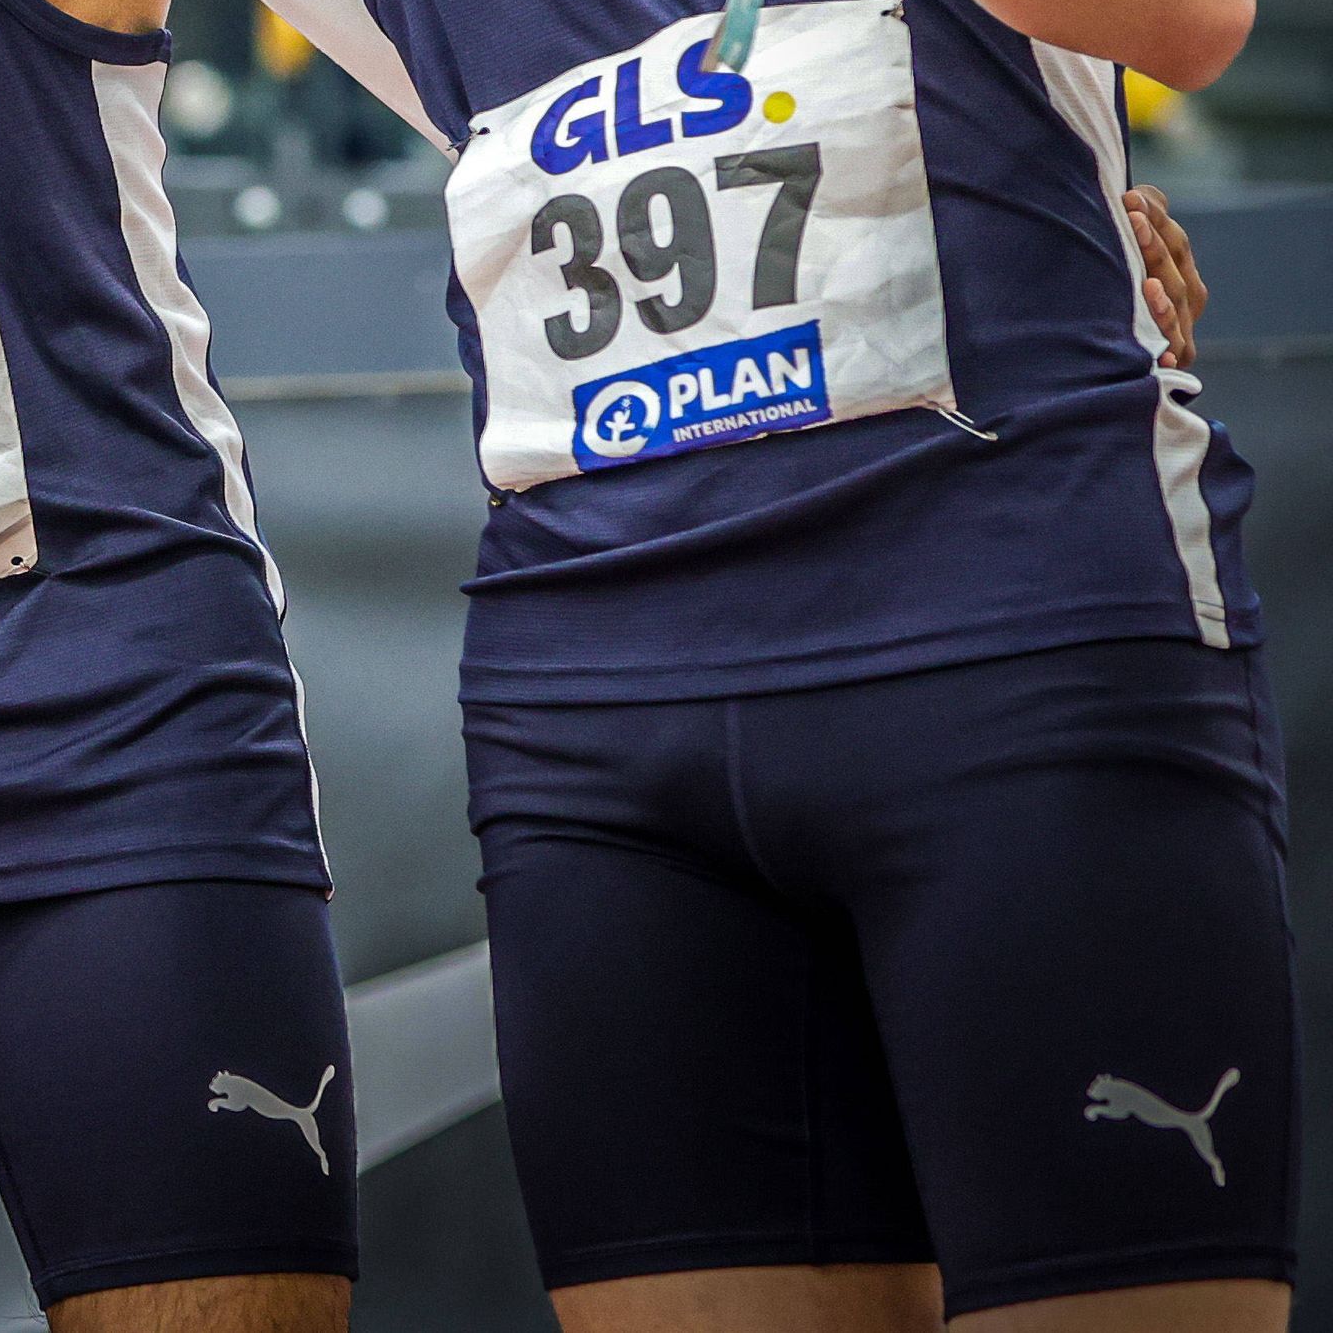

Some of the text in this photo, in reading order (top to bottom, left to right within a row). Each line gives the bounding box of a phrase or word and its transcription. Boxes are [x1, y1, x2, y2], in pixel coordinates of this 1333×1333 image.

[531, 142, 821, 361] 397
[668, 348, 812, 419] PLAN
[673, 397, 817, 442] INTERNATIONAL
